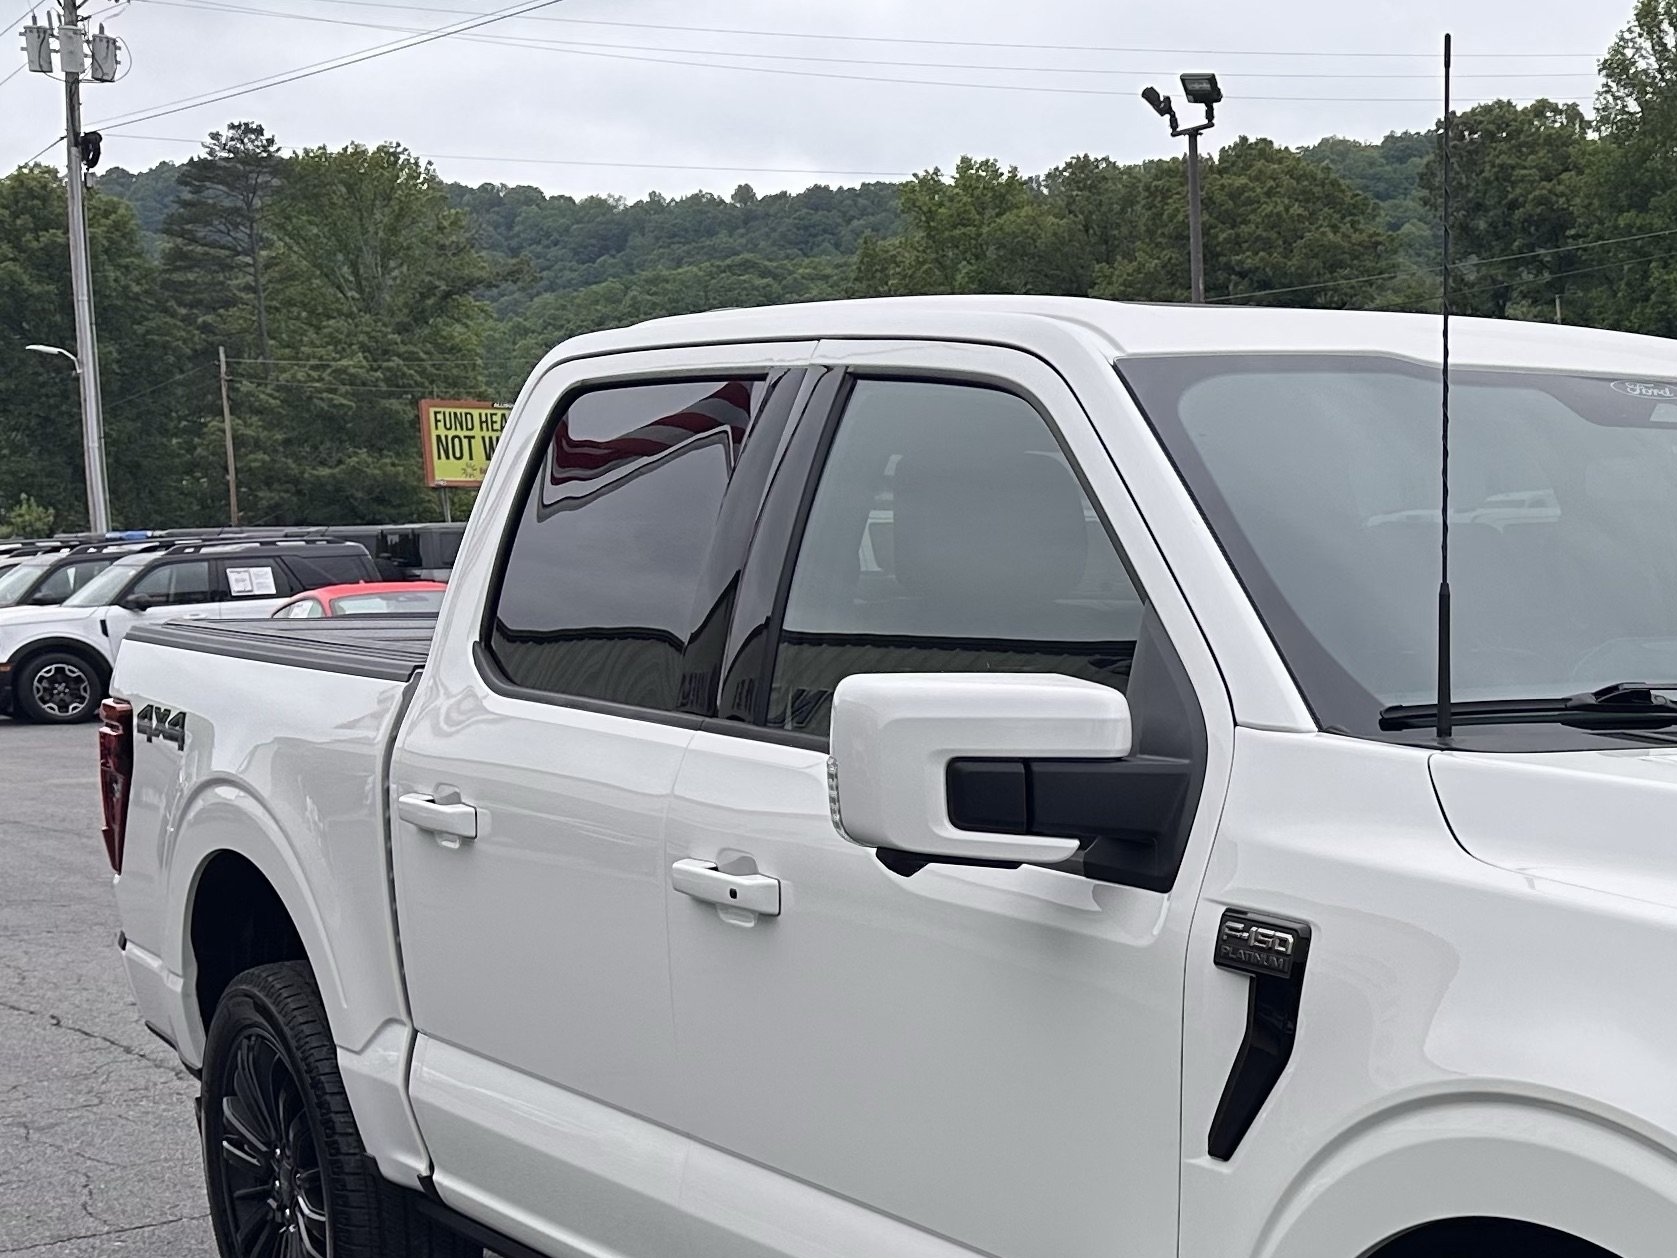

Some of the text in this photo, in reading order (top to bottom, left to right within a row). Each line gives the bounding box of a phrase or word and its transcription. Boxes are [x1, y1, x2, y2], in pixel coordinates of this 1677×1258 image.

[1625, 381, 1674, 397] Ford
[433, 411, 508, 433] FUND HEA
[435, 434, 501, 461] NOT W
[1222, 920, 1294, 955] F-150
[1220, 945, 1291, 973] PLATINUM
